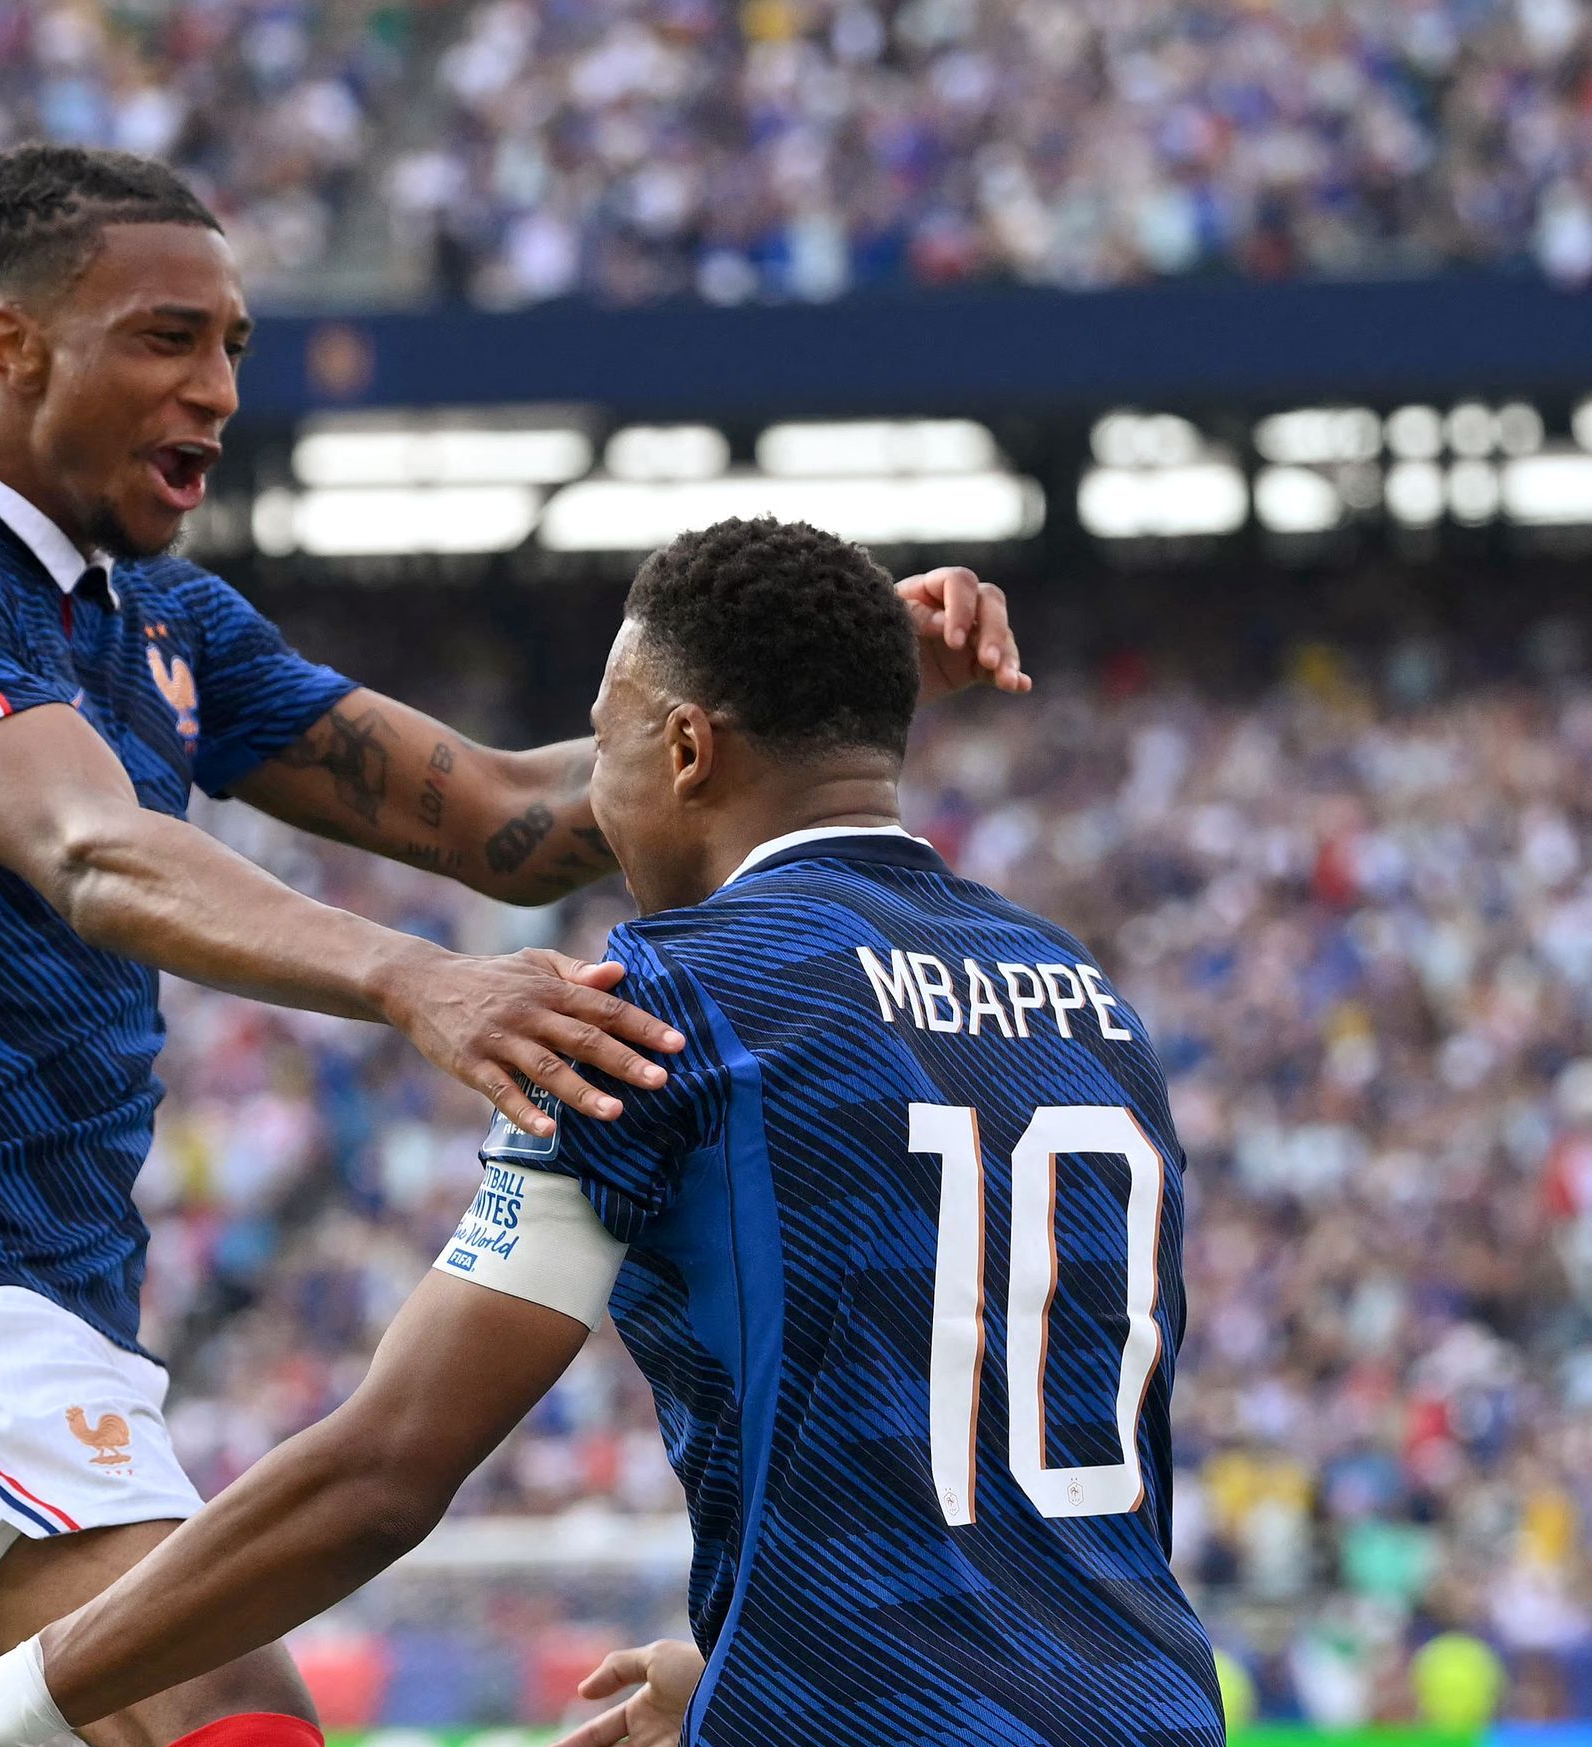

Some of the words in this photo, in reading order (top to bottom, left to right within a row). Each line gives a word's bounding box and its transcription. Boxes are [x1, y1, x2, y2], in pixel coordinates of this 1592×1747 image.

[856, 946, 1133, 1041] MBAPPE
[483, 1165, 525, 1198] TBALL
[468, 1189, 522, 1229] NITES
[465, 1222, 520, 1260] World
[908, 1102, 1164, 1526] 10
